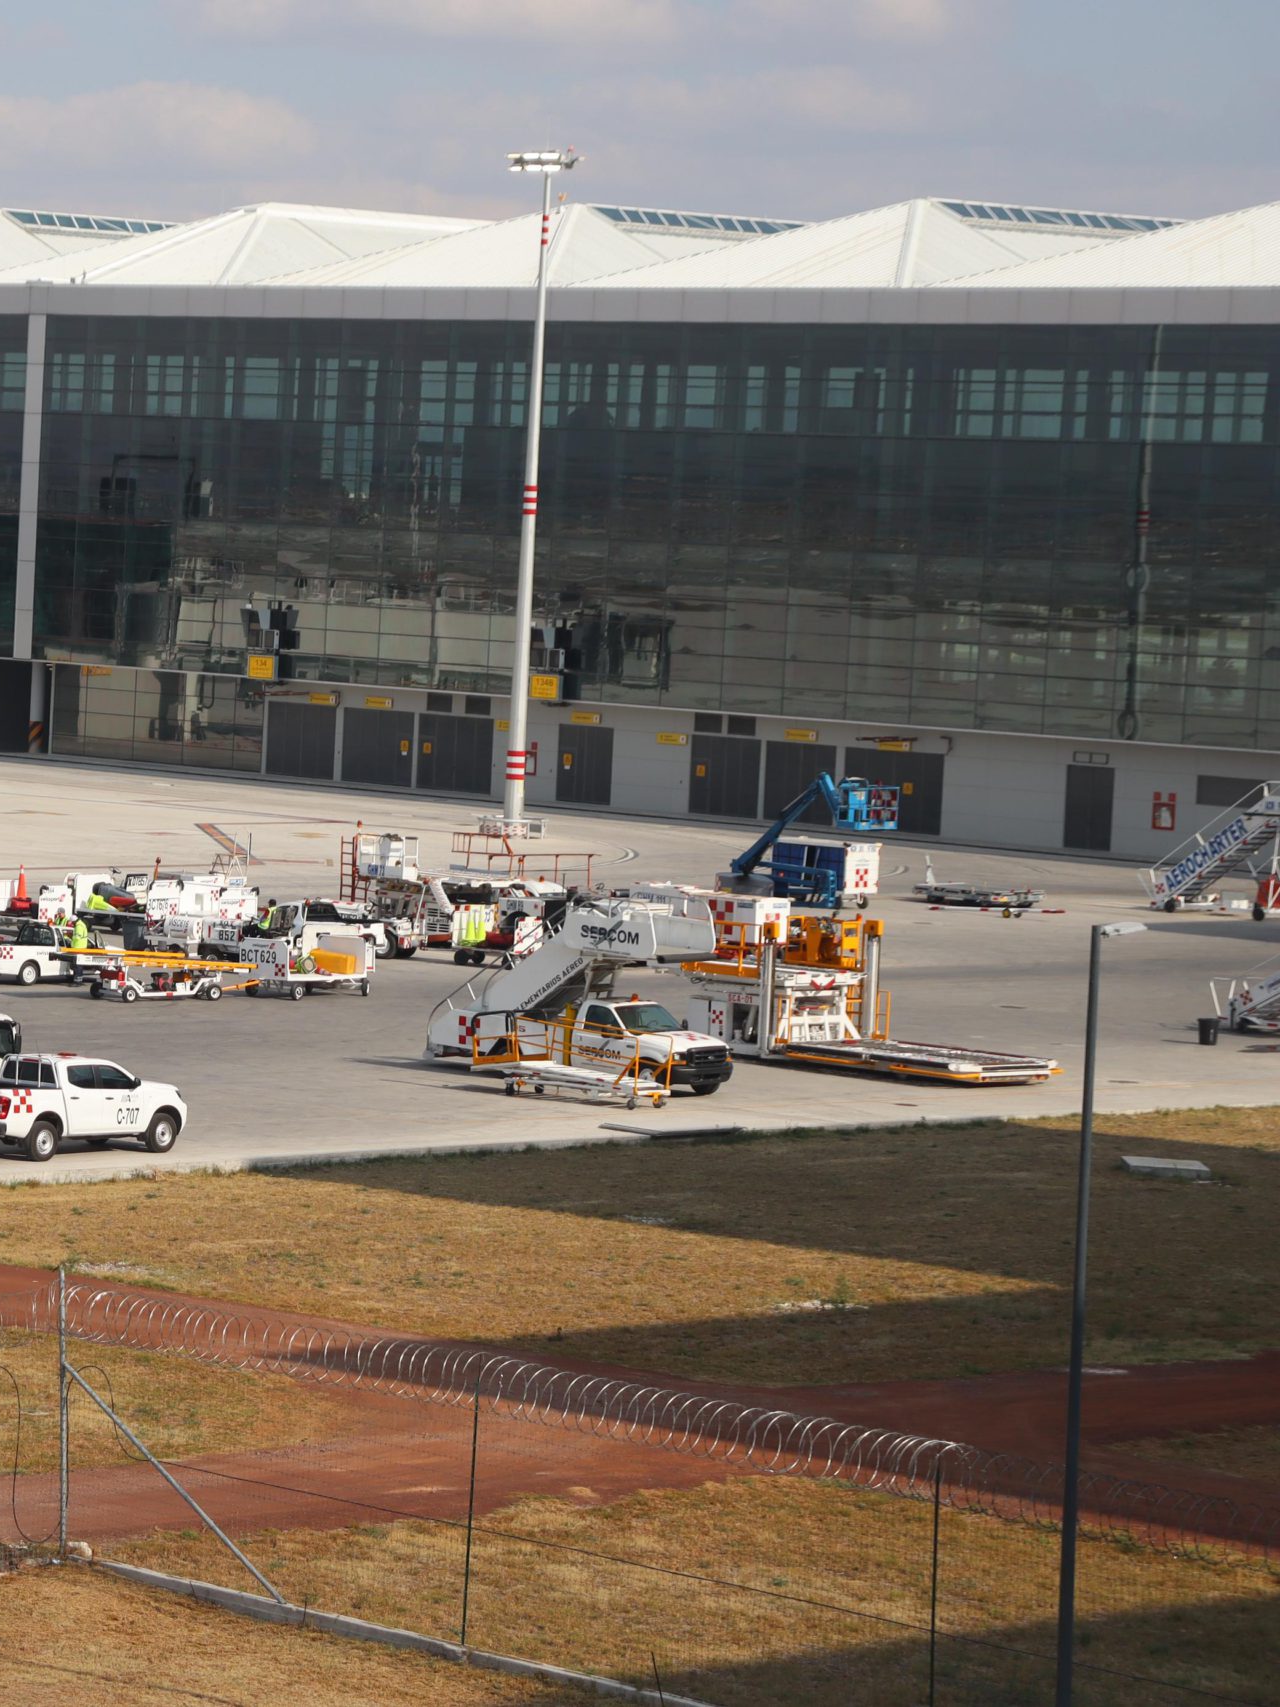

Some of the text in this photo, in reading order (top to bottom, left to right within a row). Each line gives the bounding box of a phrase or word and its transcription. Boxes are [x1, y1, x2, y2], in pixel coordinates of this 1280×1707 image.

[255, 659, 268, 668] 134
[1164, 817, 1249, 893] AEROCHARTER
[580, 924, 640, 946] SERCOM
[116, 1107, 140, 1125] C-707
